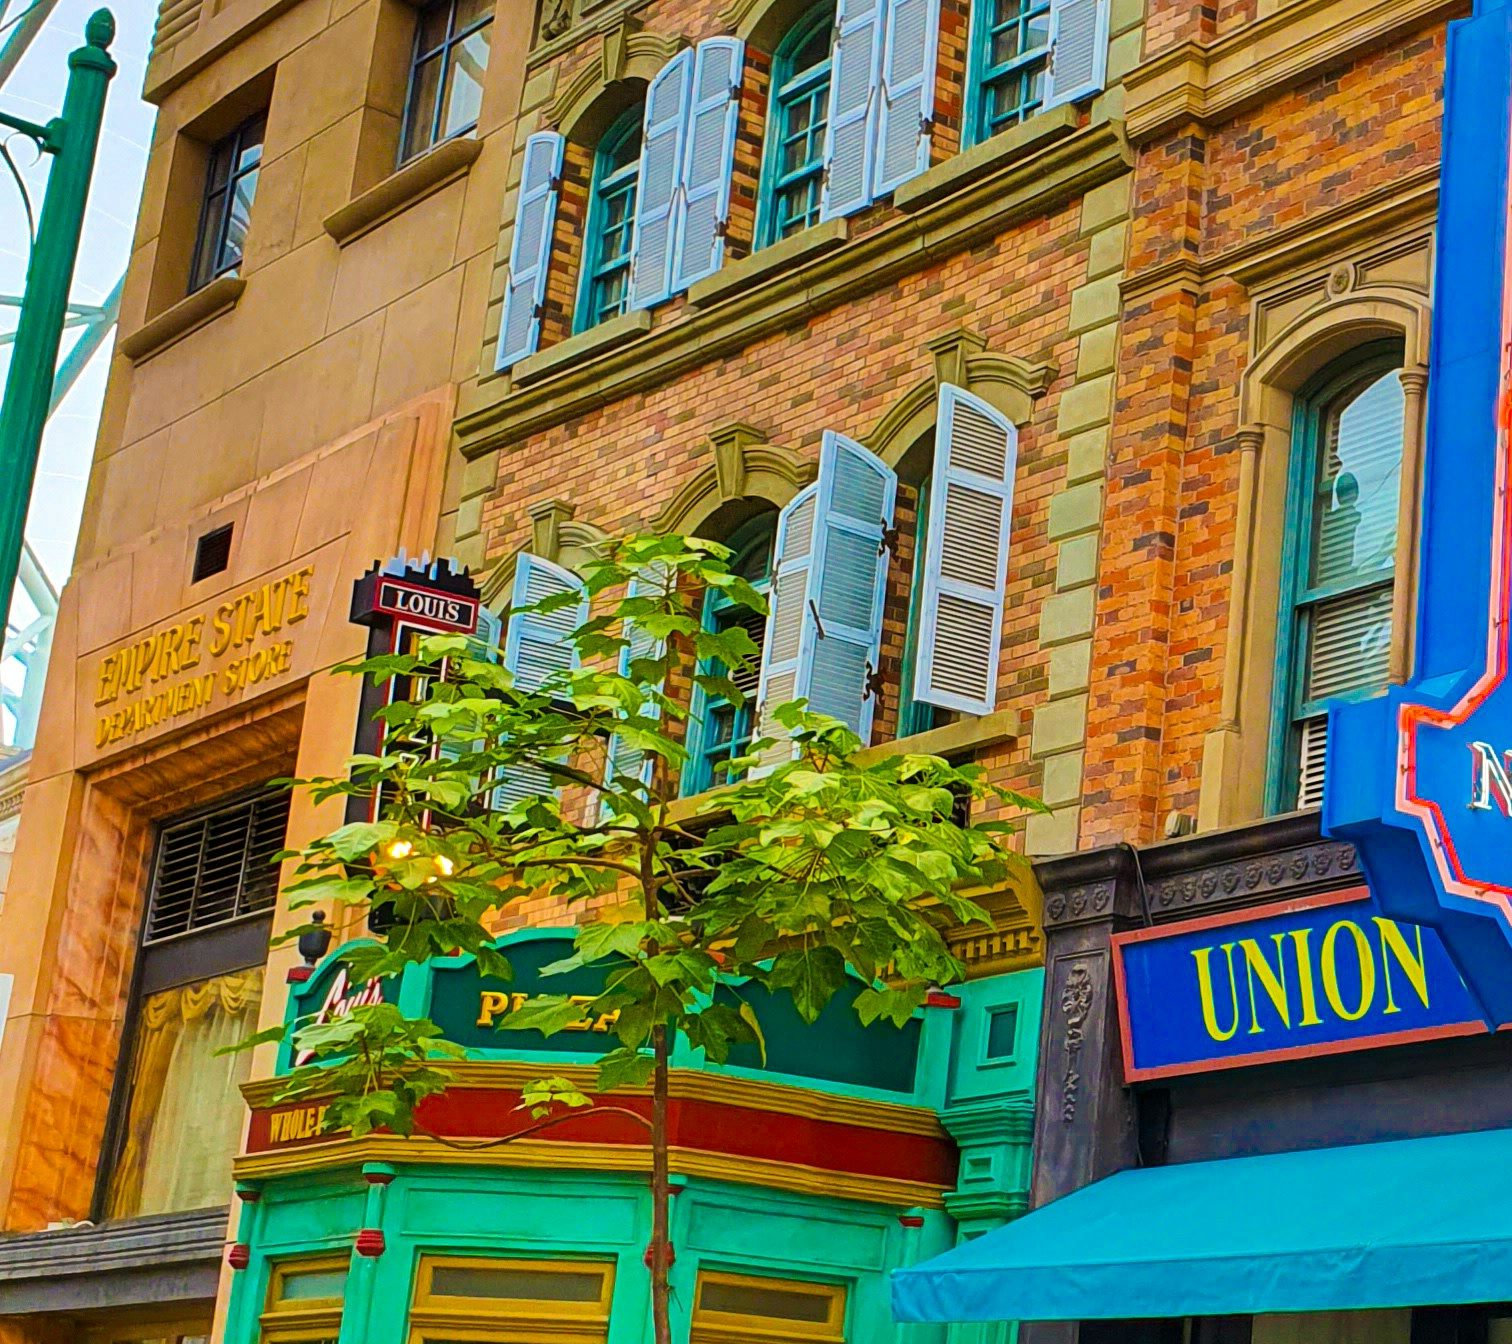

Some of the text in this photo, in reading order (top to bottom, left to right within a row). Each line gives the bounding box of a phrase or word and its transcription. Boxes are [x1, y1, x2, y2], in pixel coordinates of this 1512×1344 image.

[95, 564, 314, 707] EMPIRE STATE
[96, 640, 294, 749] DEPARTMENT STORE
[1190, 916, 1430, 1042] UNION
